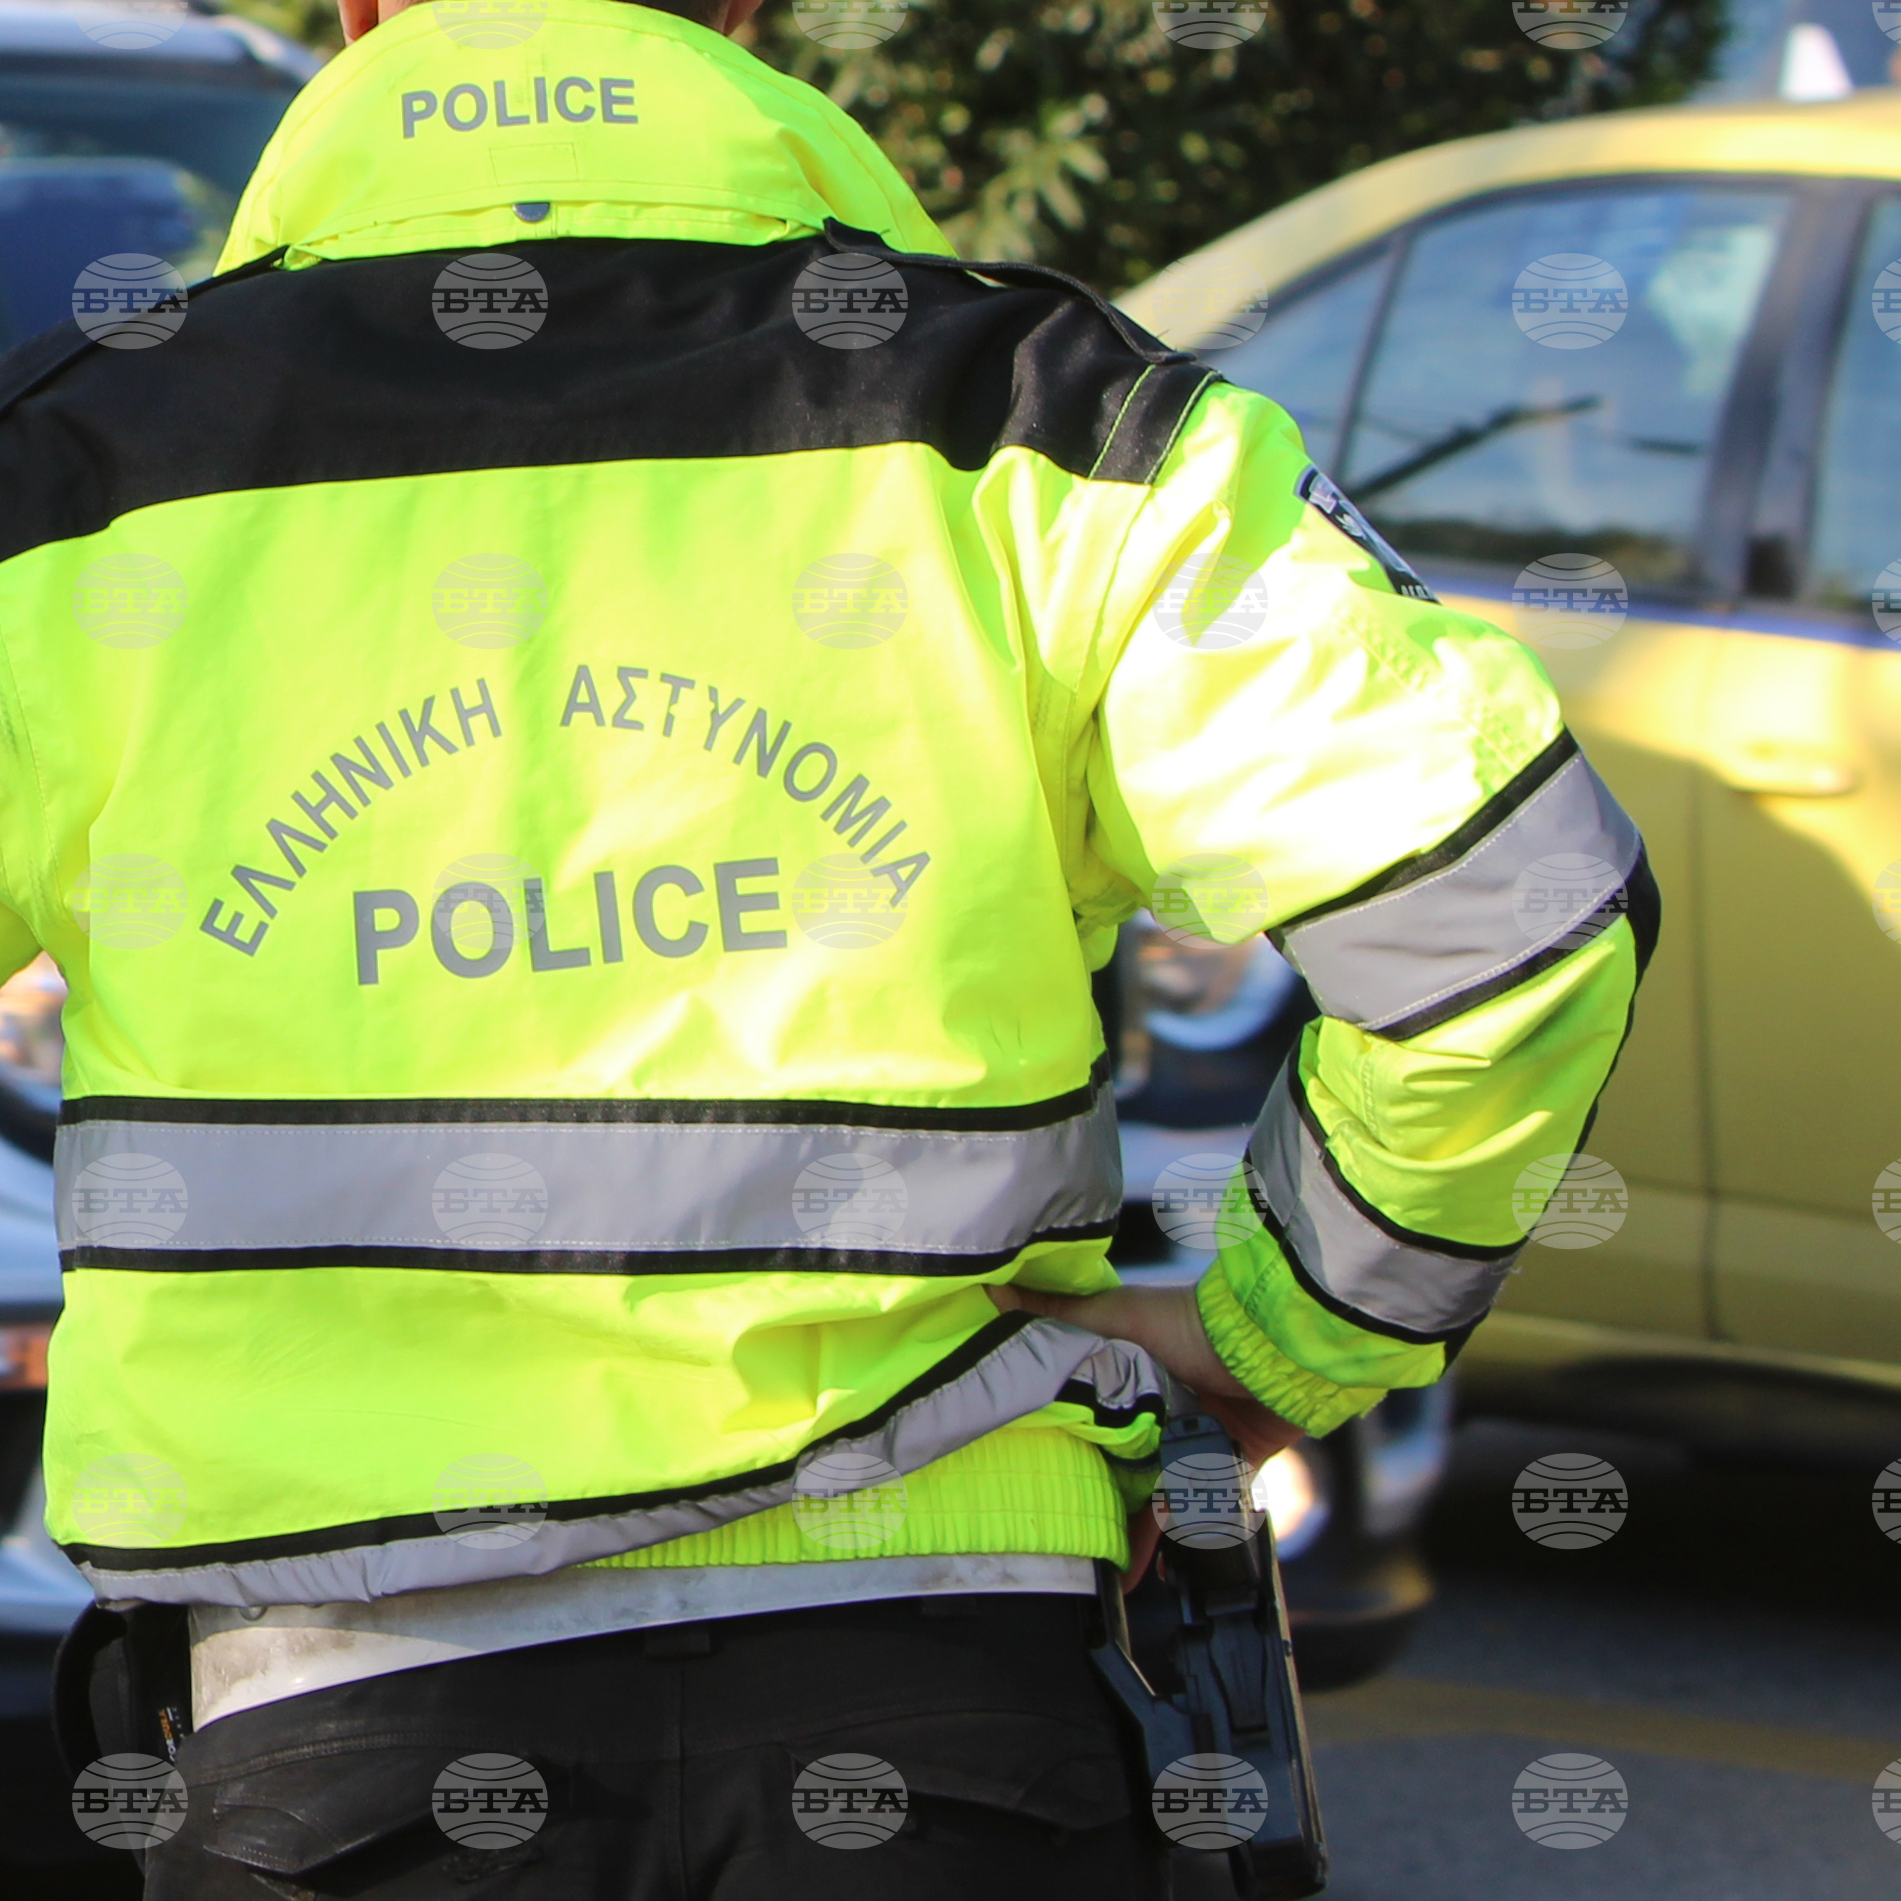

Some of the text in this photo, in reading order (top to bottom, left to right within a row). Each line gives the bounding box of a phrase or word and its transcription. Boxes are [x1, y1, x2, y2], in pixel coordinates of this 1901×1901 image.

[401, 76, 639, 139] POLICE
[199, 664, 931, 957] ΕΛΛΗΝΙΚΗ ΑΣΤΥΝΟΜΙΑ
[353, 857, 788, 986] POLICE
